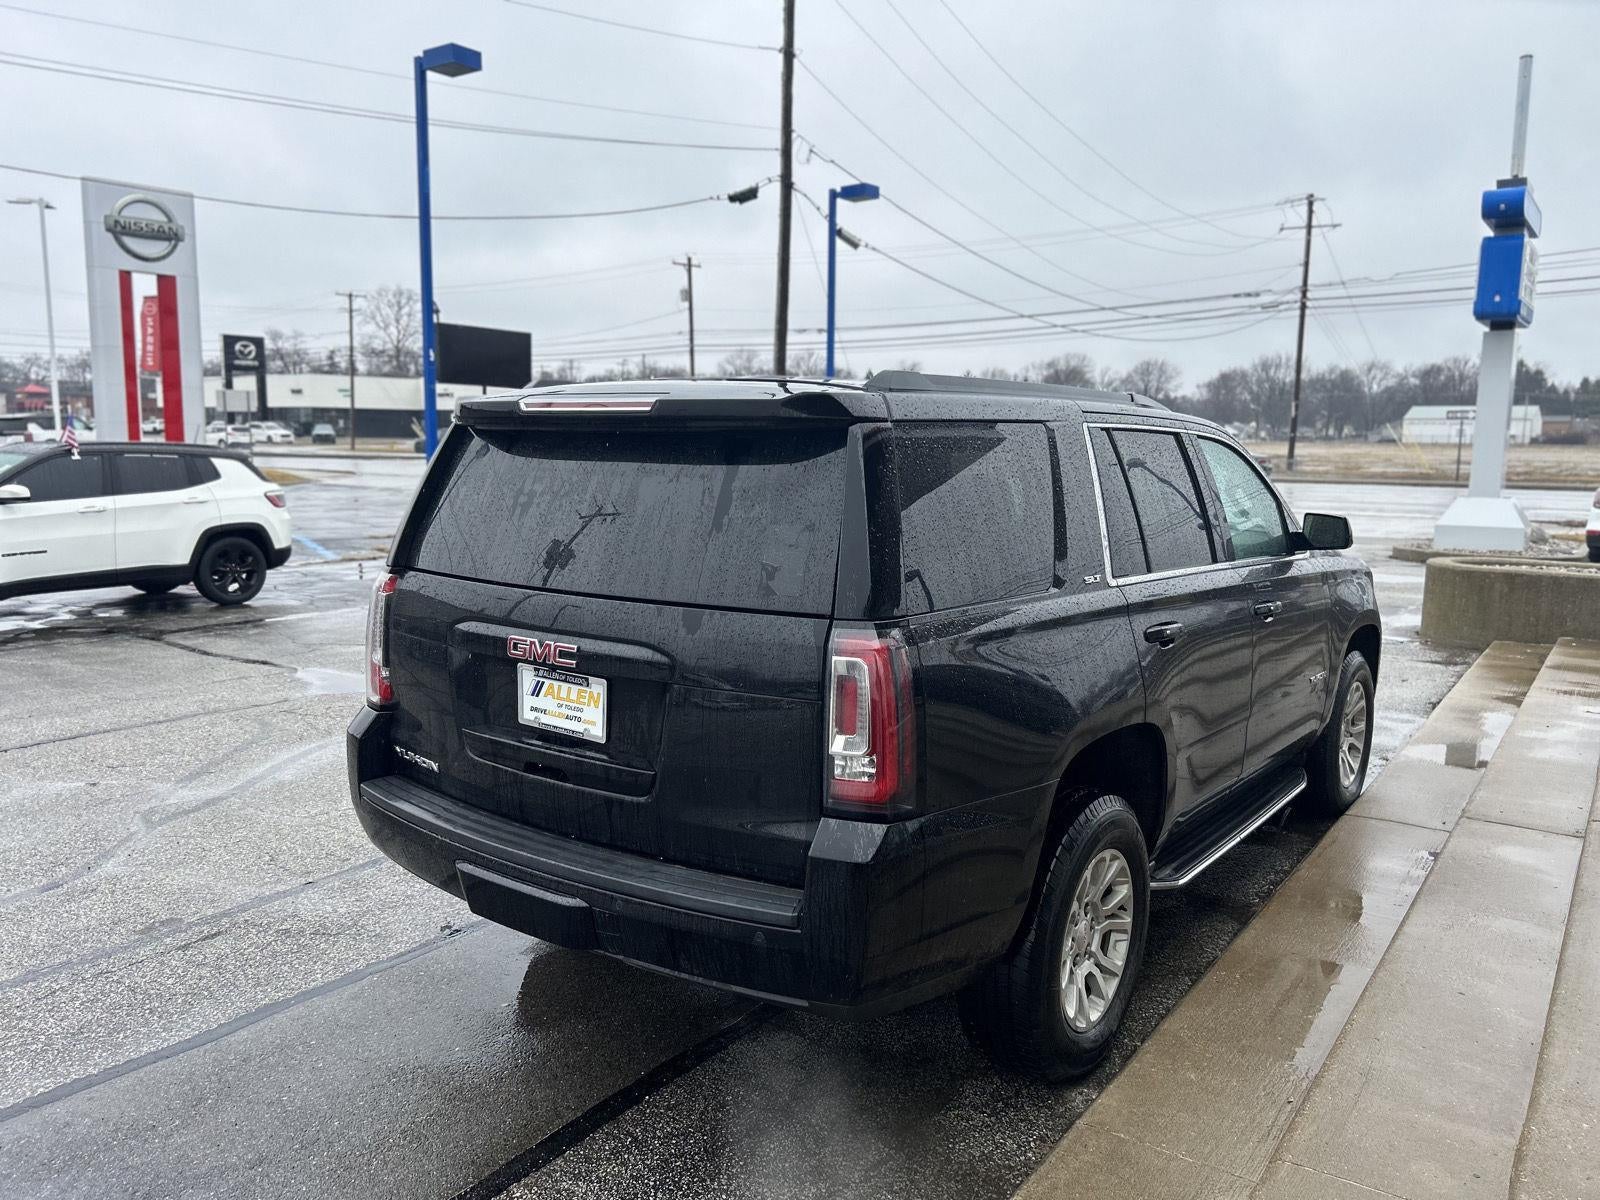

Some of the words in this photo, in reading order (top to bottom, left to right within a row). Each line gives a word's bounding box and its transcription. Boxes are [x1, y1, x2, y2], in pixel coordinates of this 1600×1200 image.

[114, 218, 179, 238] NISSAN
[507, 635, 577, 668] GMC
[543, 670, 560, 680] ALLEN
[543, 682, 601, 709] ALLEN
[564, 704, 584, 713] TOLEDO
